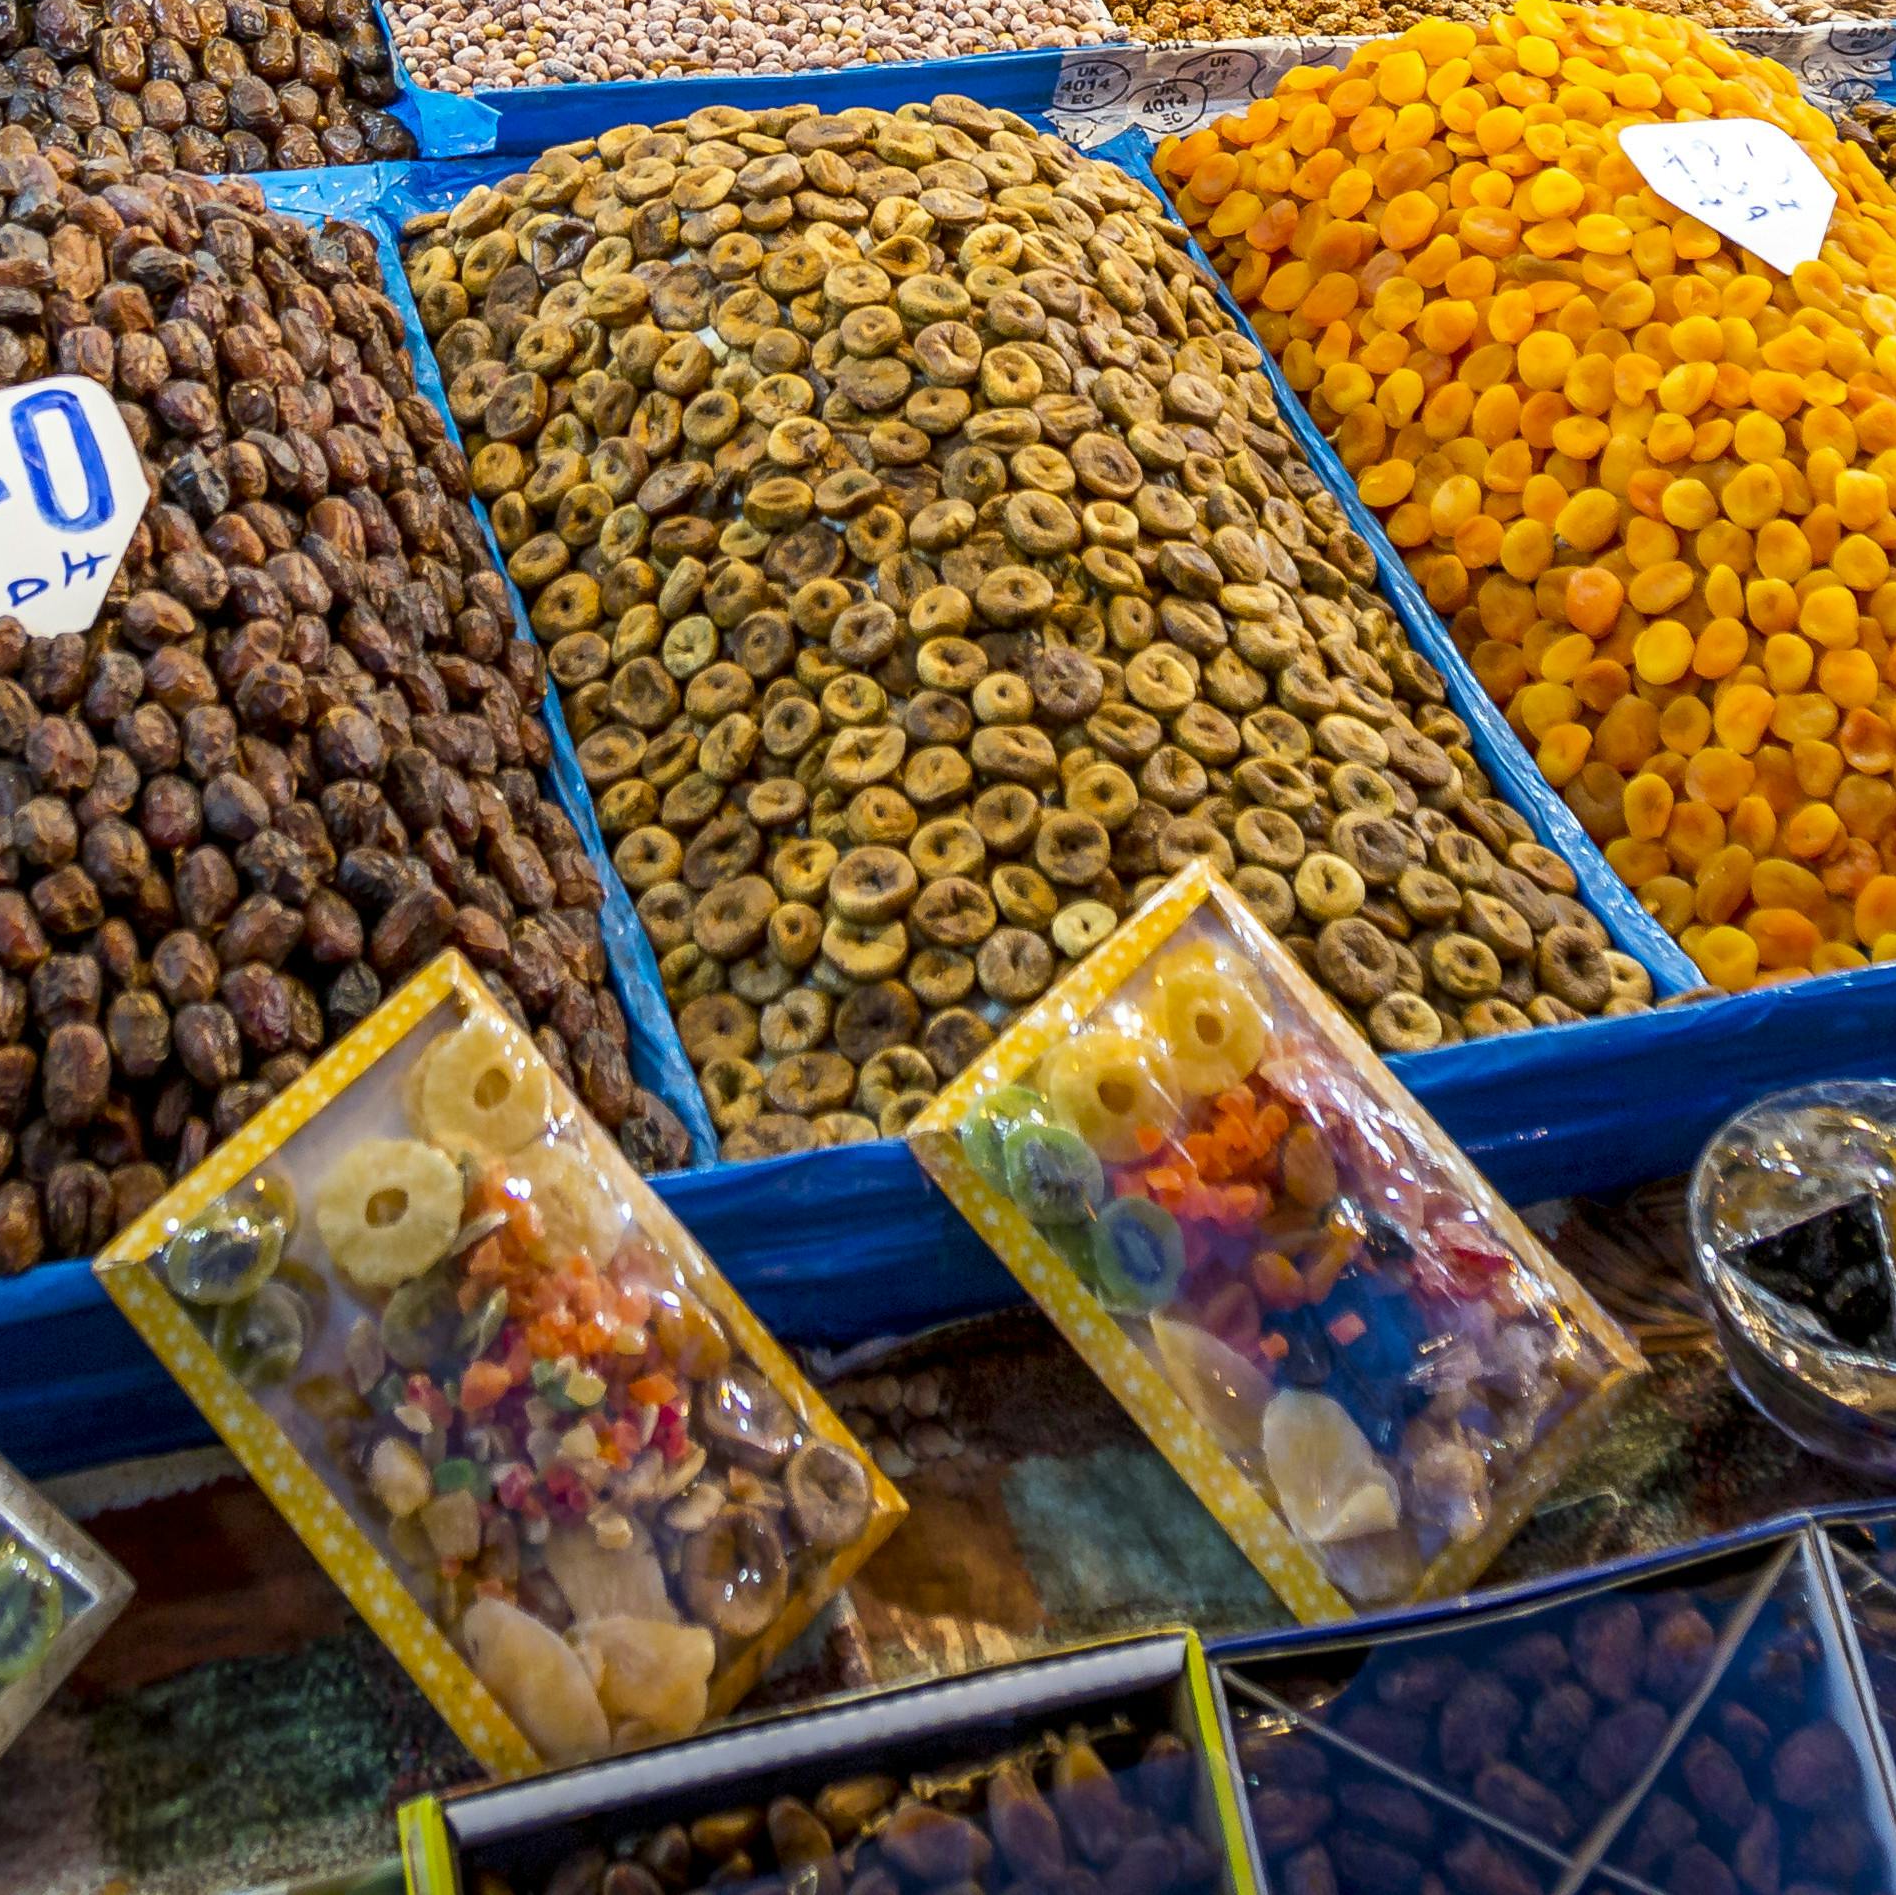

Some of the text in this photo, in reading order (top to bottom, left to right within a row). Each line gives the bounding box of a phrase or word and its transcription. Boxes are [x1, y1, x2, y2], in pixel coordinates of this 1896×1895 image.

[1078, 66, 1103, 77] UK
[1060, 78, 1111, 93] 4014
[1071, 93, 1095, 105] EC
[1141, 94, 1190, 115] 4014
[7, 550, 111, 607] DH
